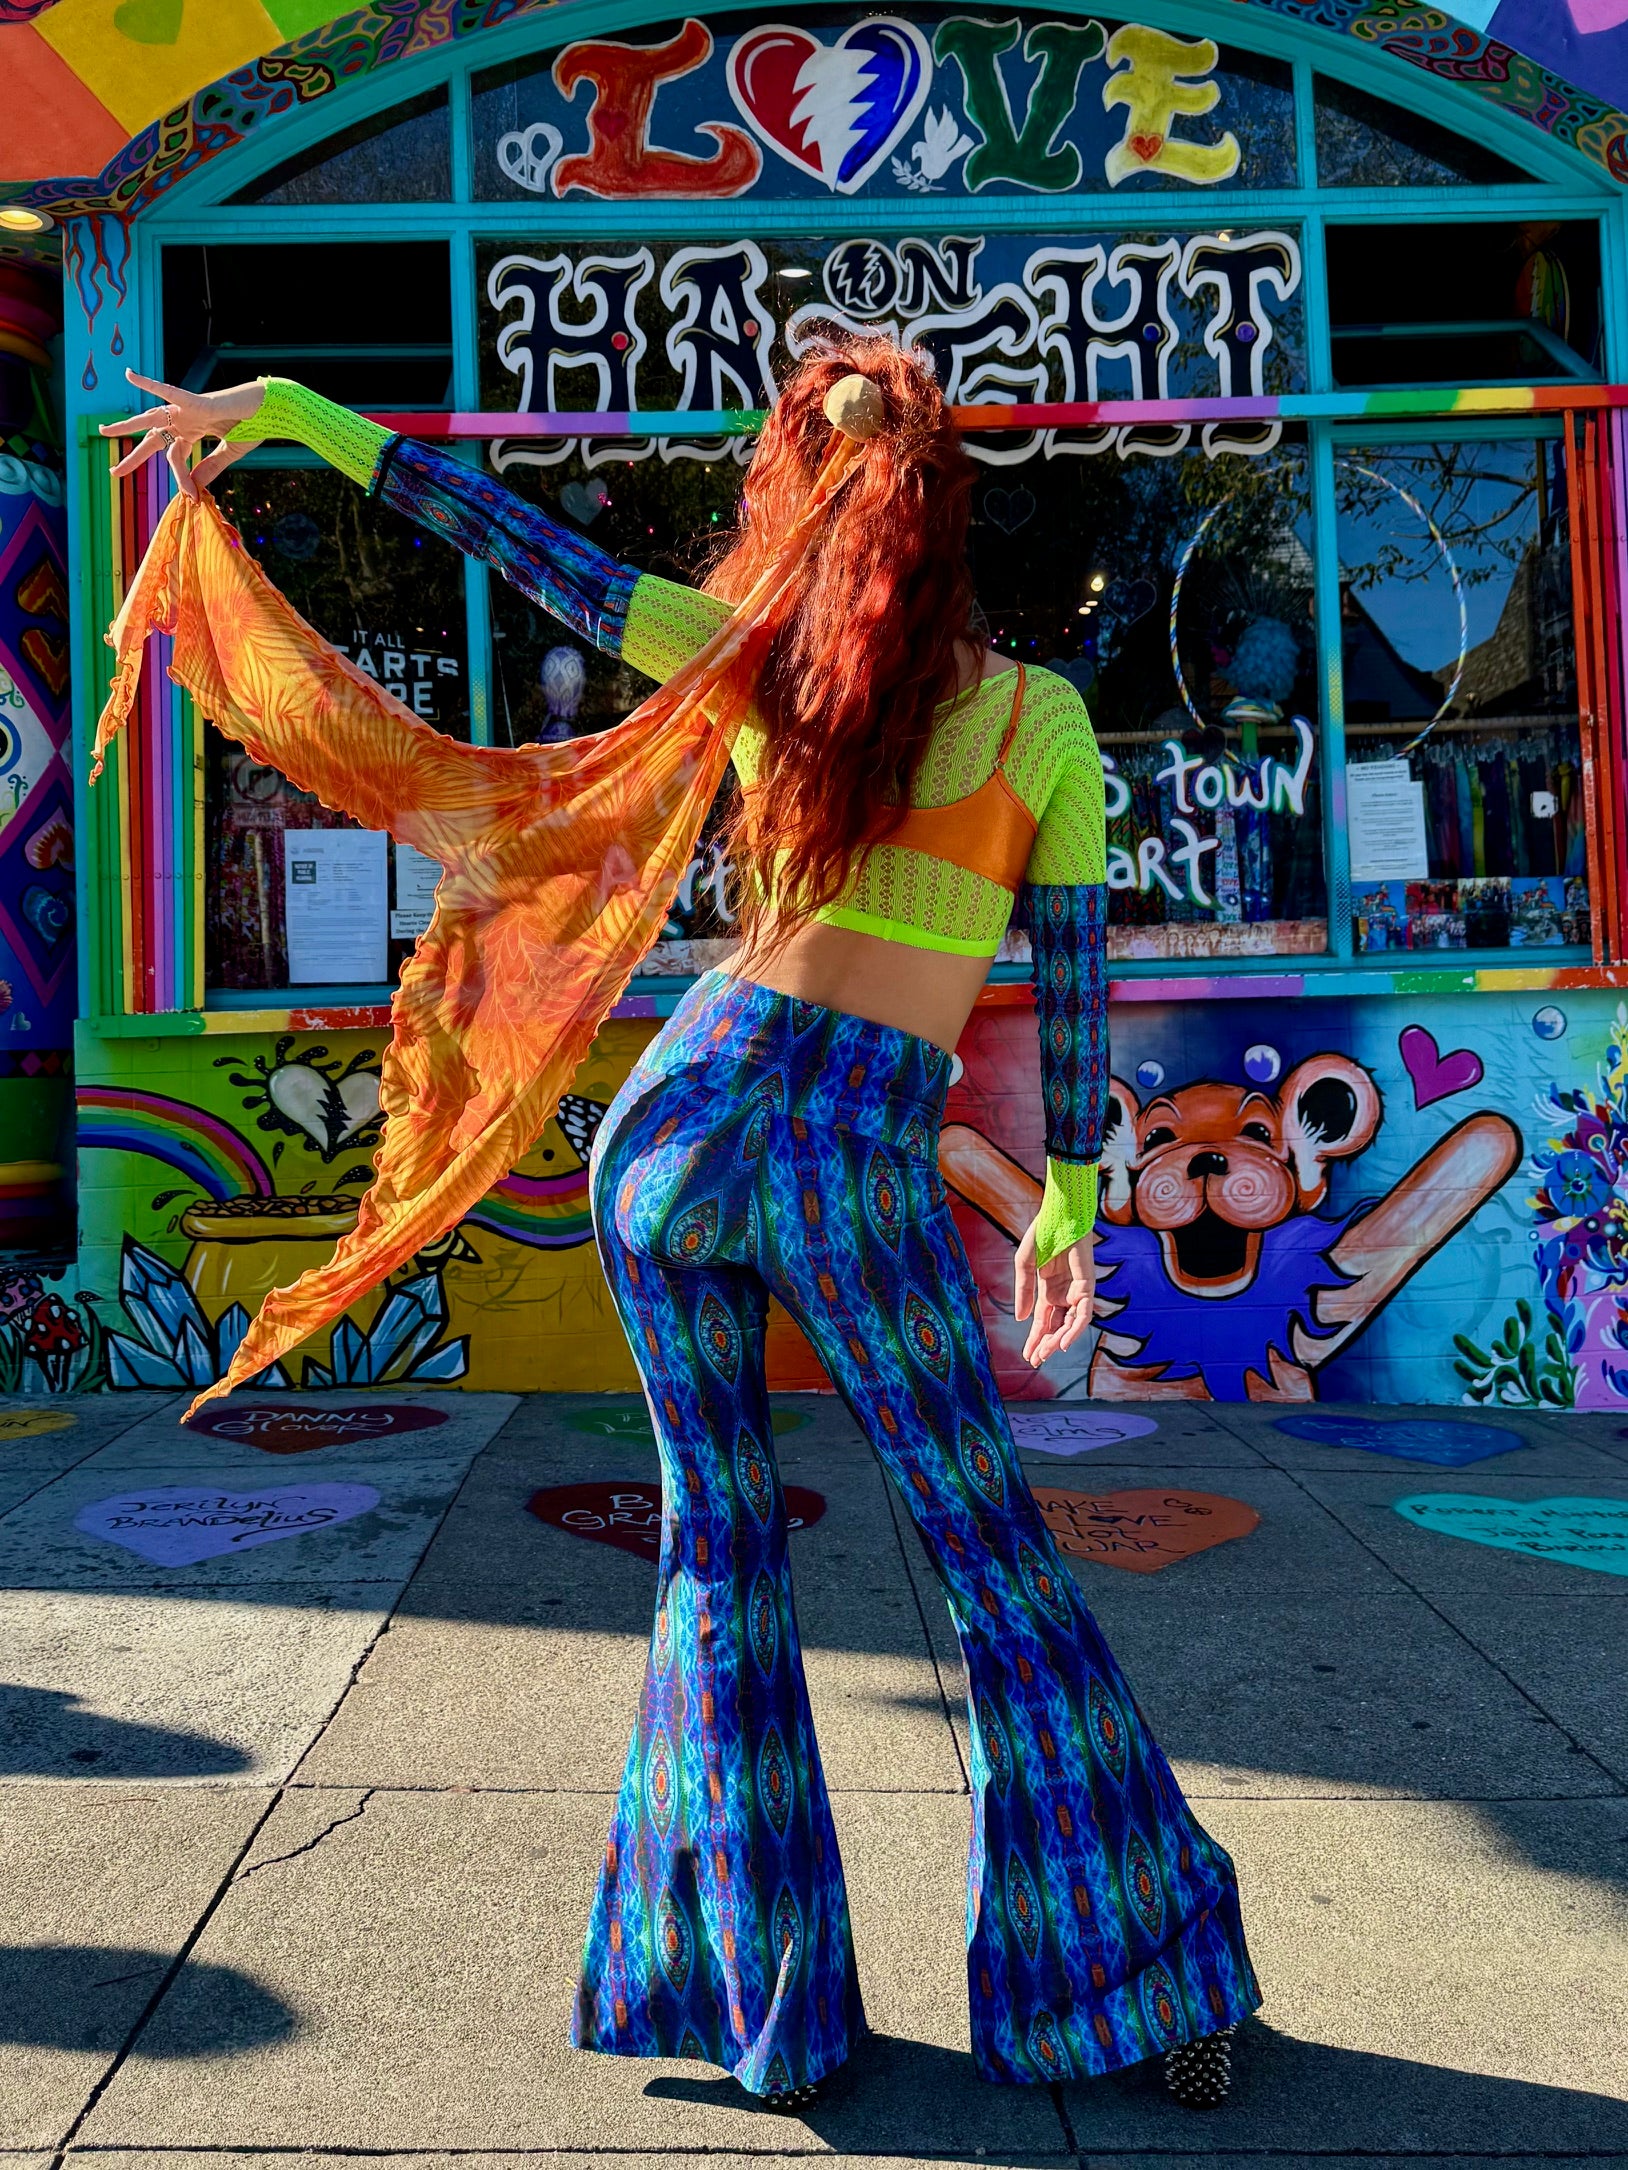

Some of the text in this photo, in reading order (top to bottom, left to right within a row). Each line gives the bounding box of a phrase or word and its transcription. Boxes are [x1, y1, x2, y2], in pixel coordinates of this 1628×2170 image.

[552, 17, 1242, 199] LOVE
[823, 235, 985, 318] ON
[353, 630, 405, 649] IT ALL
[242, 1411, 395, 1425] DANNY
[1062, 1539, 1186, 1553] WAR
